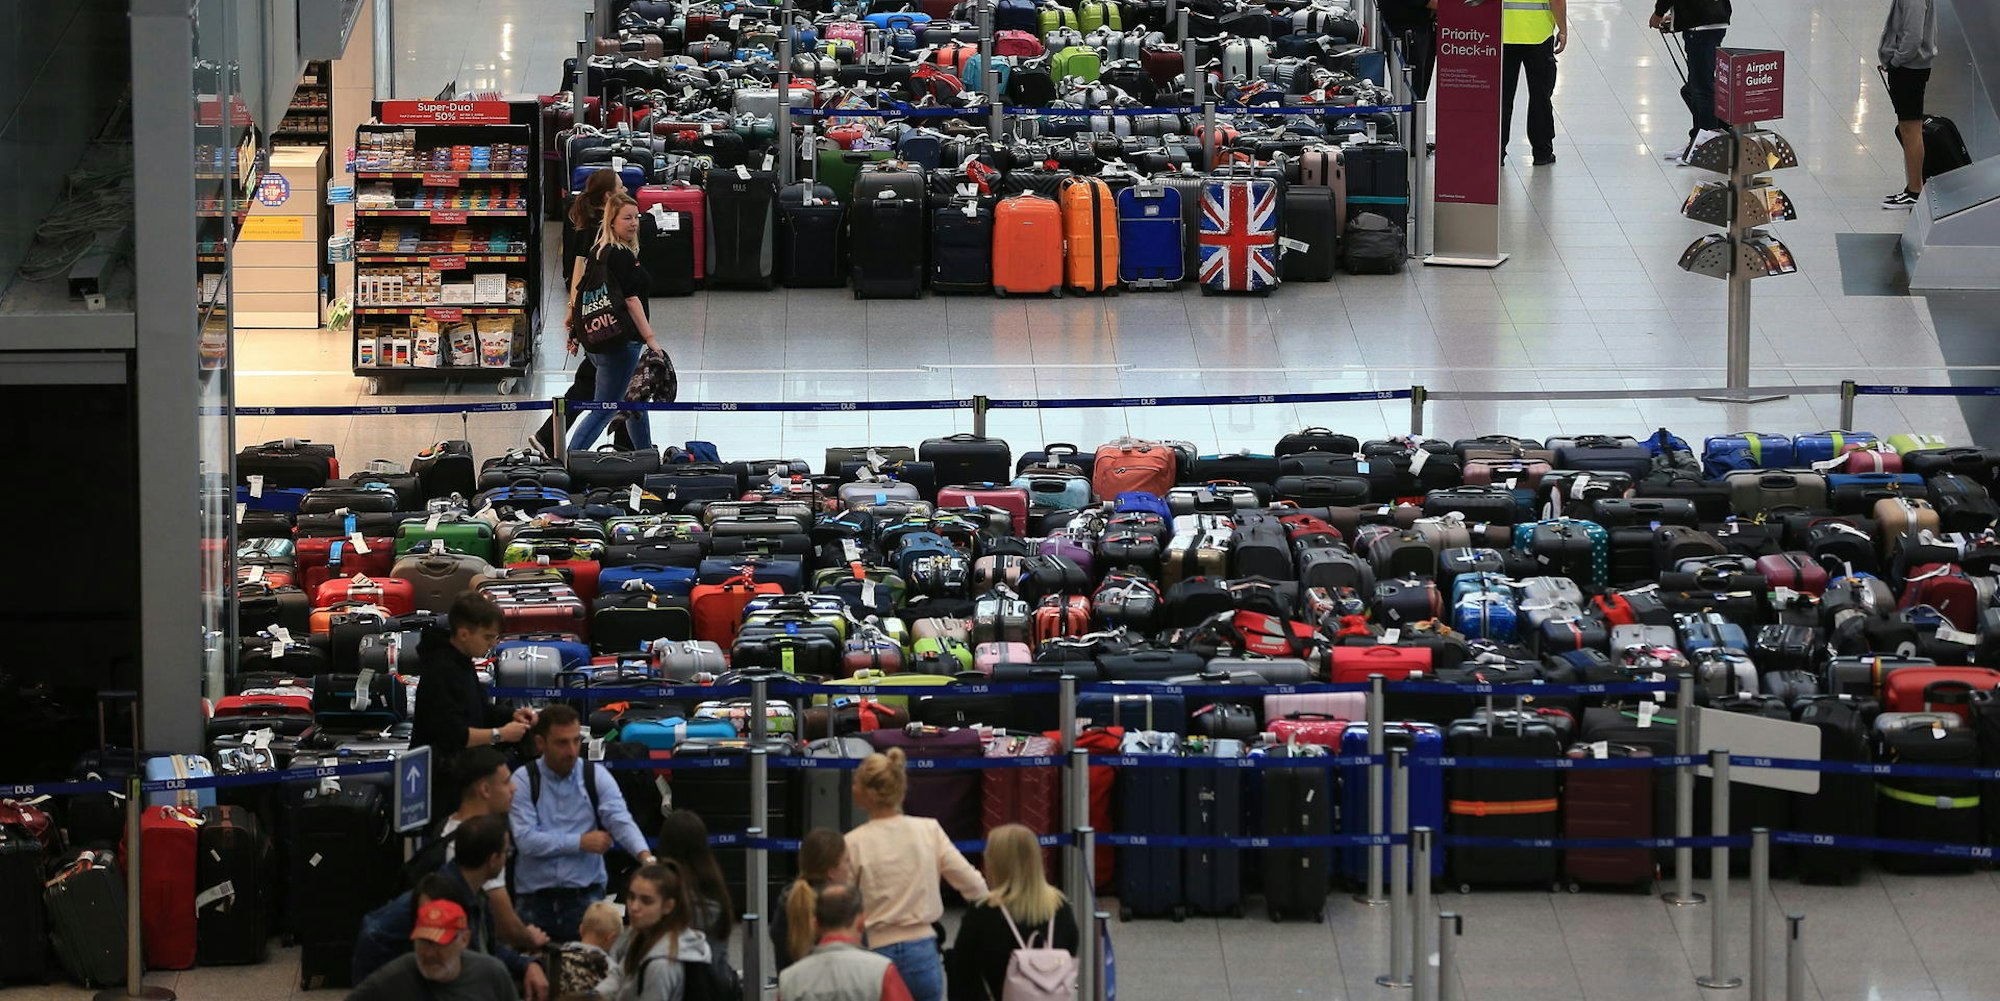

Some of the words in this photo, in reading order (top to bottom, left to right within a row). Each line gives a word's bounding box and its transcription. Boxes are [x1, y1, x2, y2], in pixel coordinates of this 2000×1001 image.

[1441, 28, 1490, 43] Priority-
[1441, 43, 1496, 56] Check-in
[1746, 60, 1778, 74] Airport
[1746, 74, 1773, 86] Guide
[418, 103, 474, 112] Super-Duo!
[585, 314, 617, 333] LOVE
[316, 768, 335, 776] DUS
[166, 780, 186, 788] DUS
[15, 785, 34, 794] DUS
[1814, 835, 1834, 845] DUS
[1971, 847, 1992, 857] DUS
